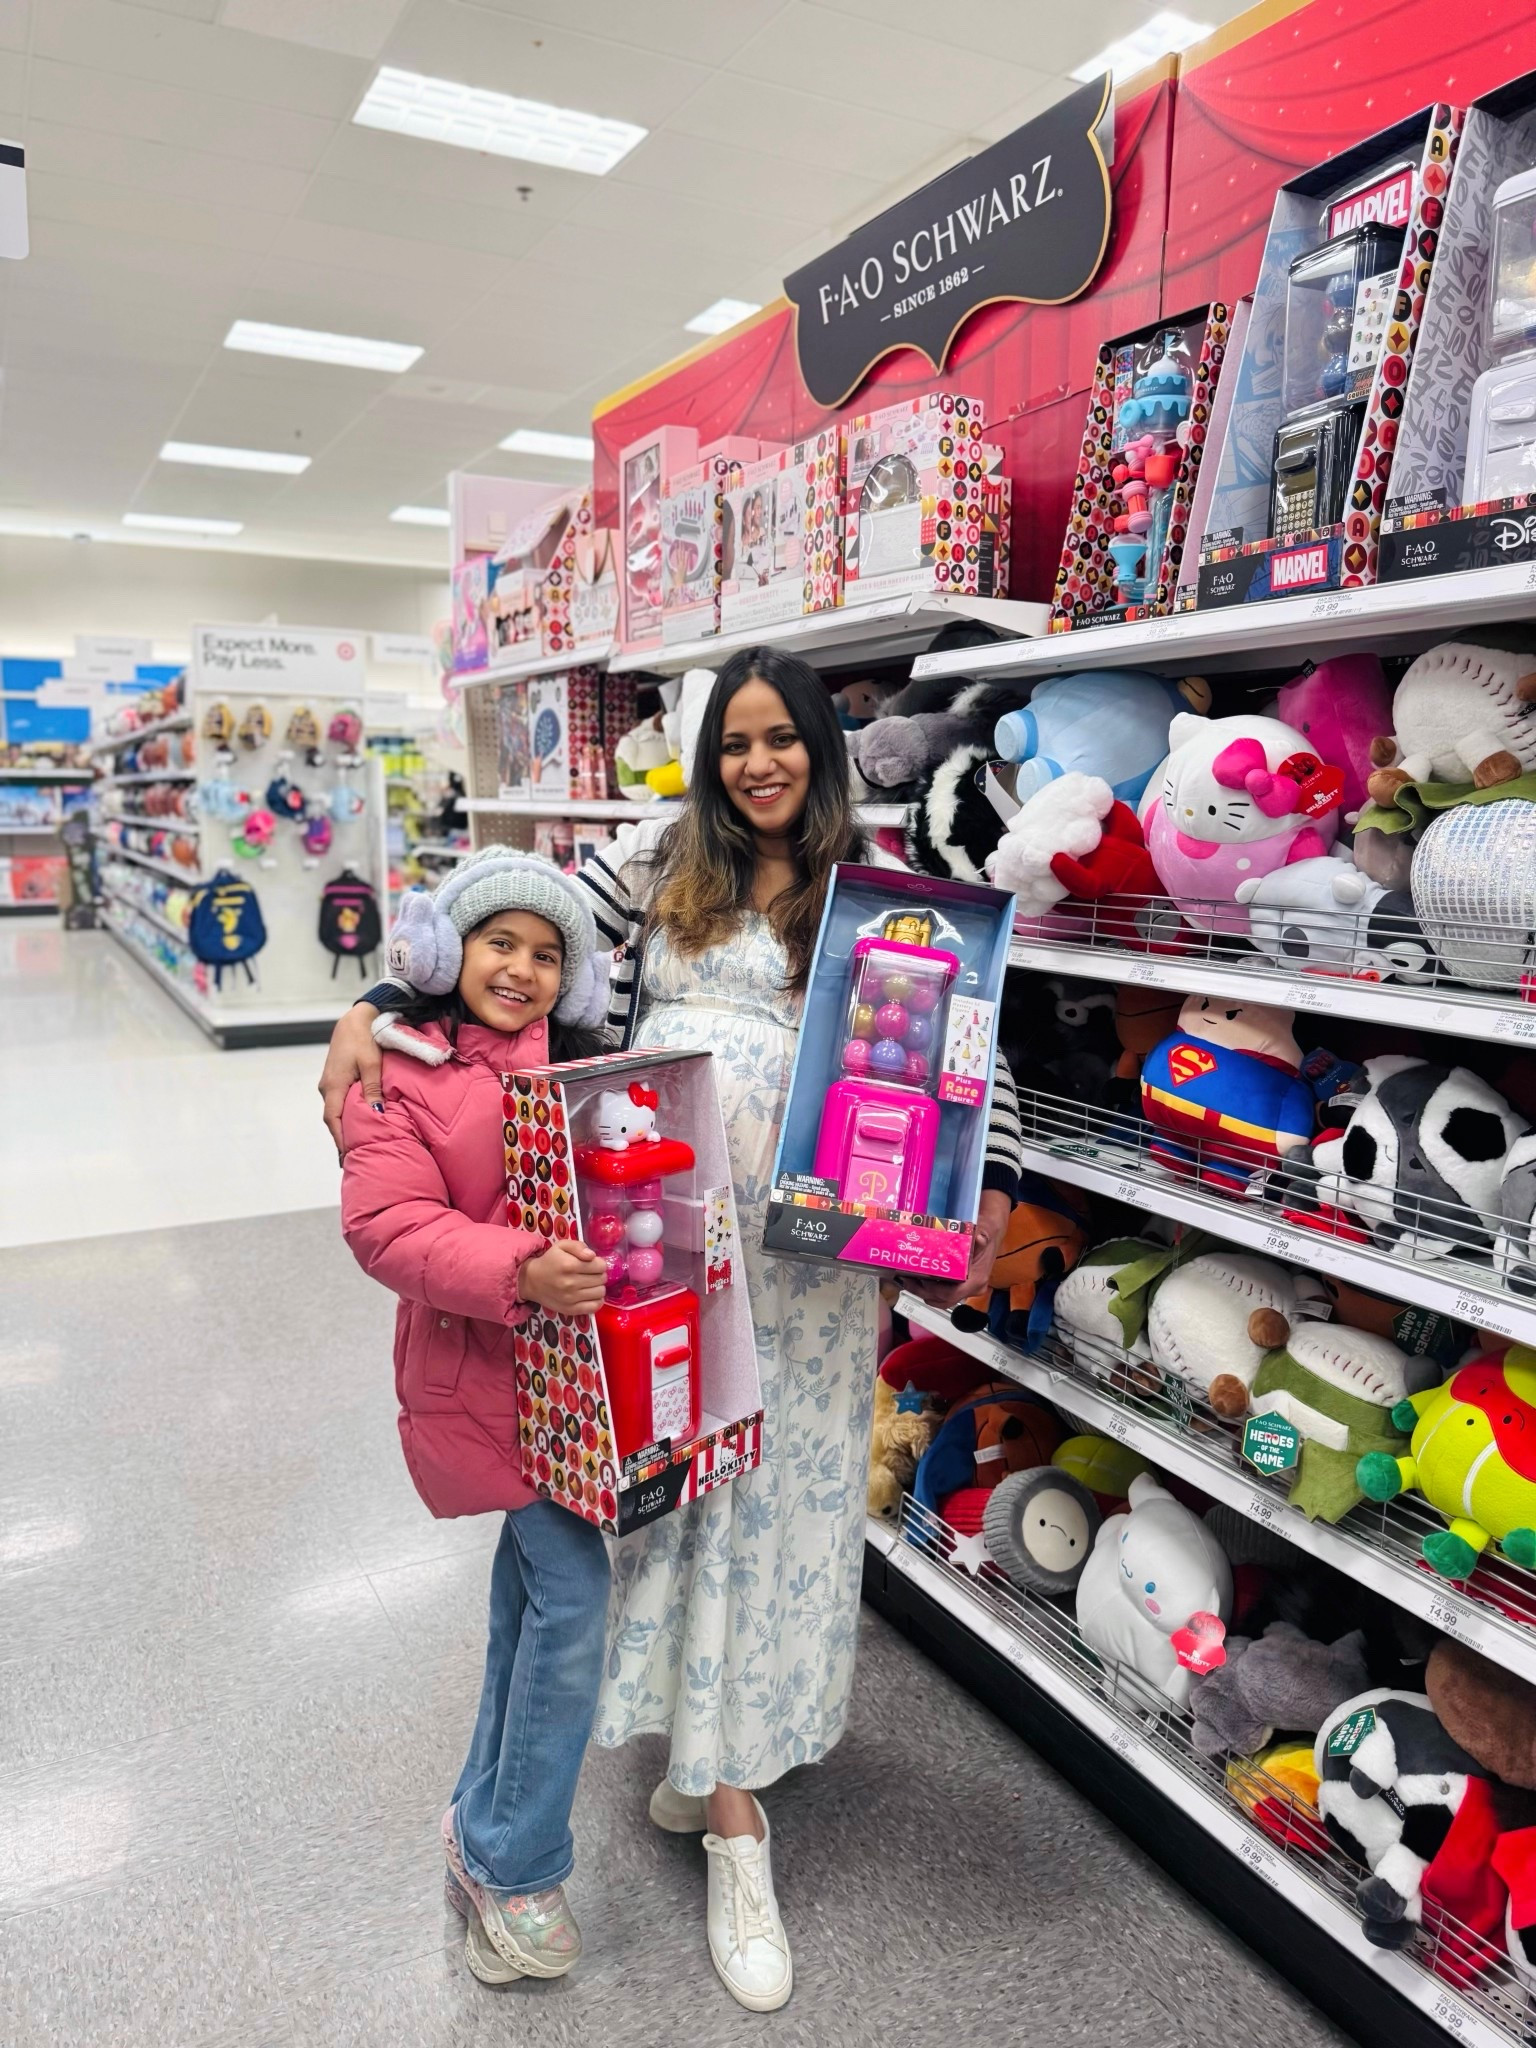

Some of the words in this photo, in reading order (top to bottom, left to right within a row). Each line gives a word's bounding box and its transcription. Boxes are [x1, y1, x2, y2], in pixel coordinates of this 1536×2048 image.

[1333, 179, 1408, 238] MARVEL
[893, 285, 936, 319] SINCE
[939, 267, 969, 296] 1862
[1404, 491, 1433, 505] WARNING:
[1400, 553, 1439, 566] SCHWARZ
[1273, 550, 1326, 587] MARVEL
[1312, 603, 1339, 614] 39.99
[203, 634, 264, 654] Expect
[270, 637, 317, 656] More.
[203, 652, 235, 671] Pay
[241, 653, 285, 670] Less.
[1299, 992, 1317, 1001] 16.99
[1512, 1021, 1535, 1032] 16.99
[955, 1076, 972, 1085] Plus
[945, 1081, 979, 1098] Rare
[946, 1092, 975, 1104] Figures
[796, 1174, 826, 1187] WARNING:
[1117, 1186, 1137, 1198] 19.99
[790, 1229, 828, 1241] SCHWARZ
[1266, 1236, 1289, 1250] 19.99
[898, 1240, 924, 1255] Disney
[869, 1247, 951, 1273] PRINCESS
[1459, 1290, 1471, 1298] FAO
[1472, 1294, 1500, 1308] SCHWARZ
[1455, 1300, 1485, 1316] 19.99
[1396, 1311, 1417, 1341] GAME
[1414, 1313, 1440, 1355] HEROES
[991, 1354, 1008, 1367] 14.99
[1108, 1421, 1127, 1435] 14.99
[1268, 1422, 1292, 1432] SCHWARZ
[1249, 1429, 1295, 1449] HEROES
[1269, 1446, 1280, 1454] THE
[698, 1464, 727, 1487] HELLO
[727, 1448, 757, 1472] KITTY
[1253, 1451, 1285, 1468] GAME
[638, 1495, 666, 1514] SCHWARZ
[1250, 1502, 1272, 1519] 14.99
[1433, 1594, 1445, 1604] FAO
[1445, 1601, 1472, 1619] SCHWARZ
[1429, 1605, 1457, 1626] 14.99
[1007, 1645, 1024, 1660] 19.99
[1110, 1732, 1129, 1750] 19.99
[1330, 1723, 1351, 1748] GAME
[1343, 1714, 1367, 1751] HEROES
[1240, 1843, 1263, 1864] 19.99
[1434, 2002, 1463, 2028] 19.99
[1440, 1993, 1451, 2004] FAO
[1452, 2002, 1478, 2026] SCHWARZ
